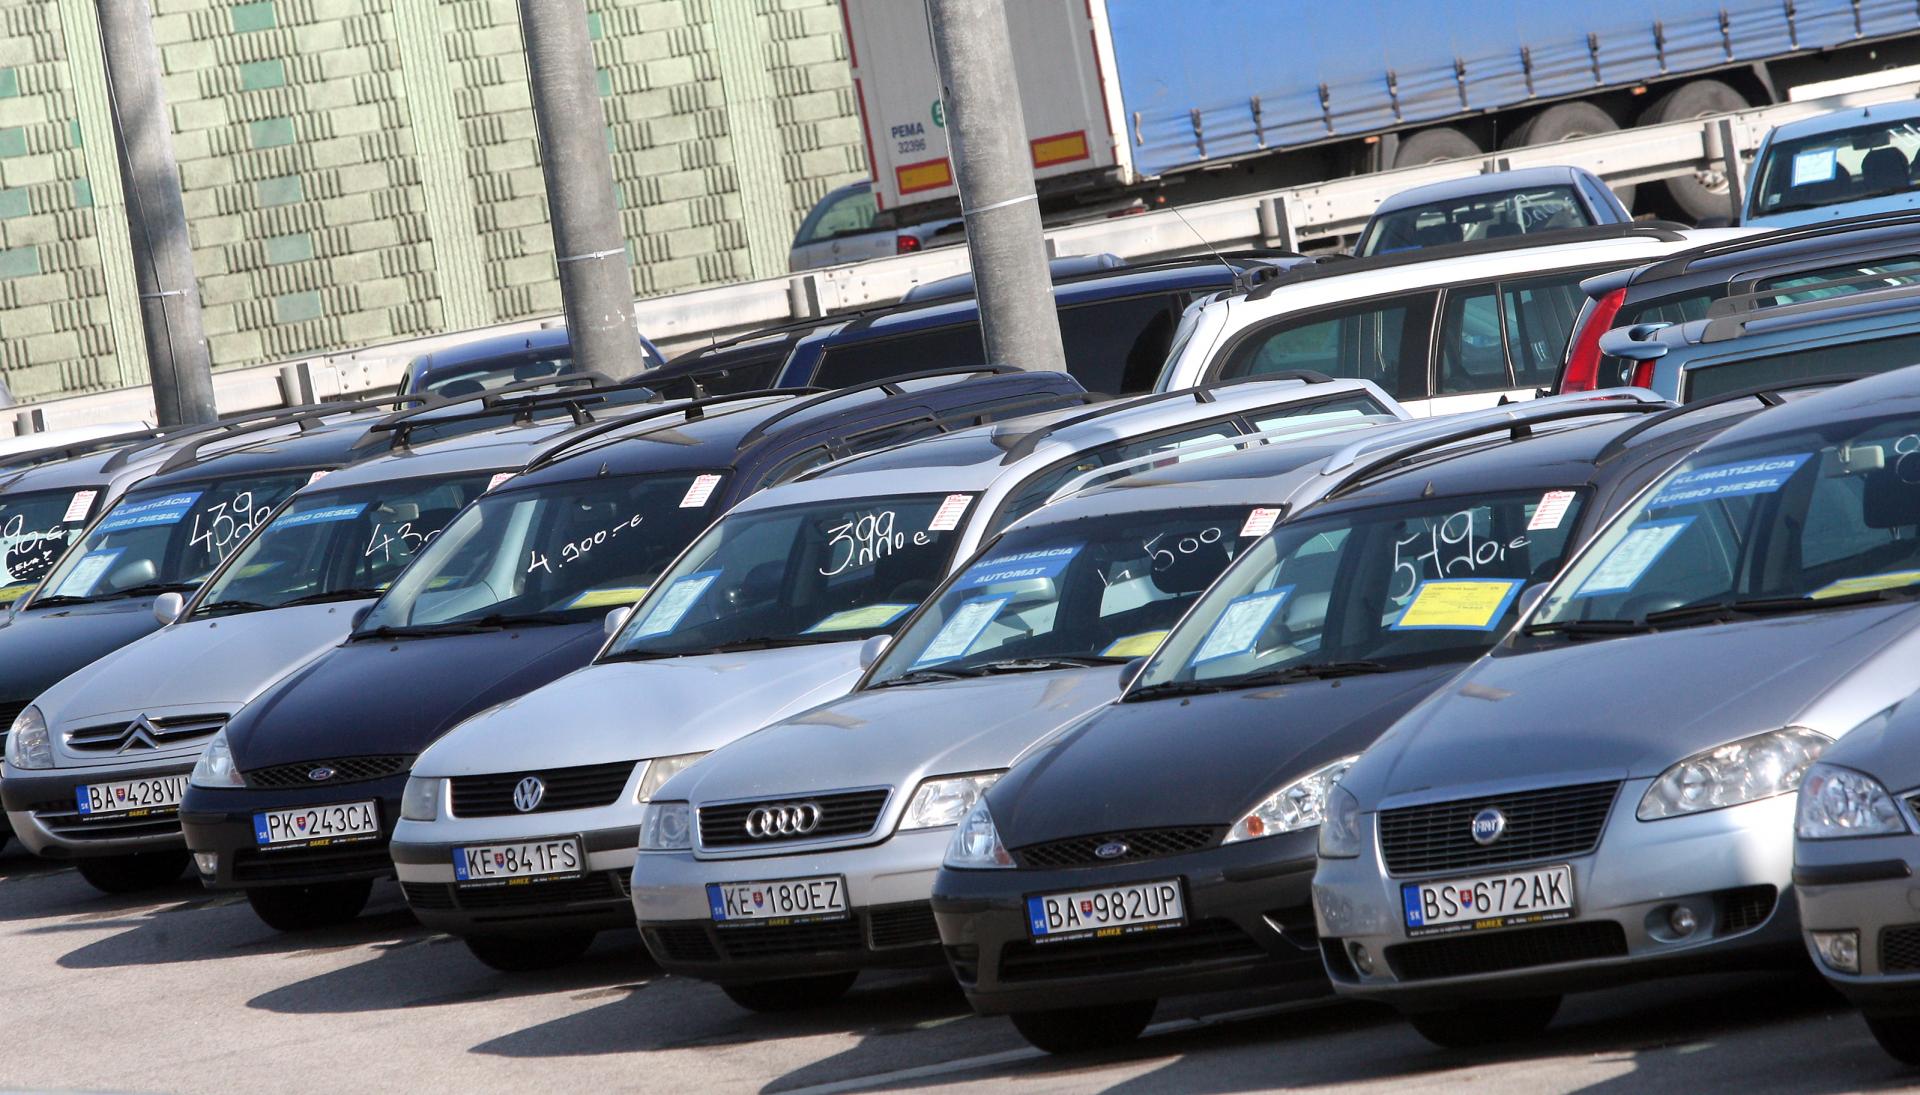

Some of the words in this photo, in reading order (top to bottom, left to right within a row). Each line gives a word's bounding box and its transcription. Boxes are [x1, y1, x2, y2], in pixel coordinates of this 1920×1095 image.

[891, 122, 924, 138] PEMA
[1652, 487, 1712, 504] TURBO
[1714, 479, 1778, 494] DIESEL
[137, 512, 180, 523] DIESEL
[271, 514, 313, 528] TURBO
[312, 508, 358, 519] DIESEL
[973, 567, 1046, 584] AUTOMAT
[1475, 819, 1498, 833] FIAT
[1409, 909, 1421, 921] SK
[1034, 919, 1044, 929] SK
